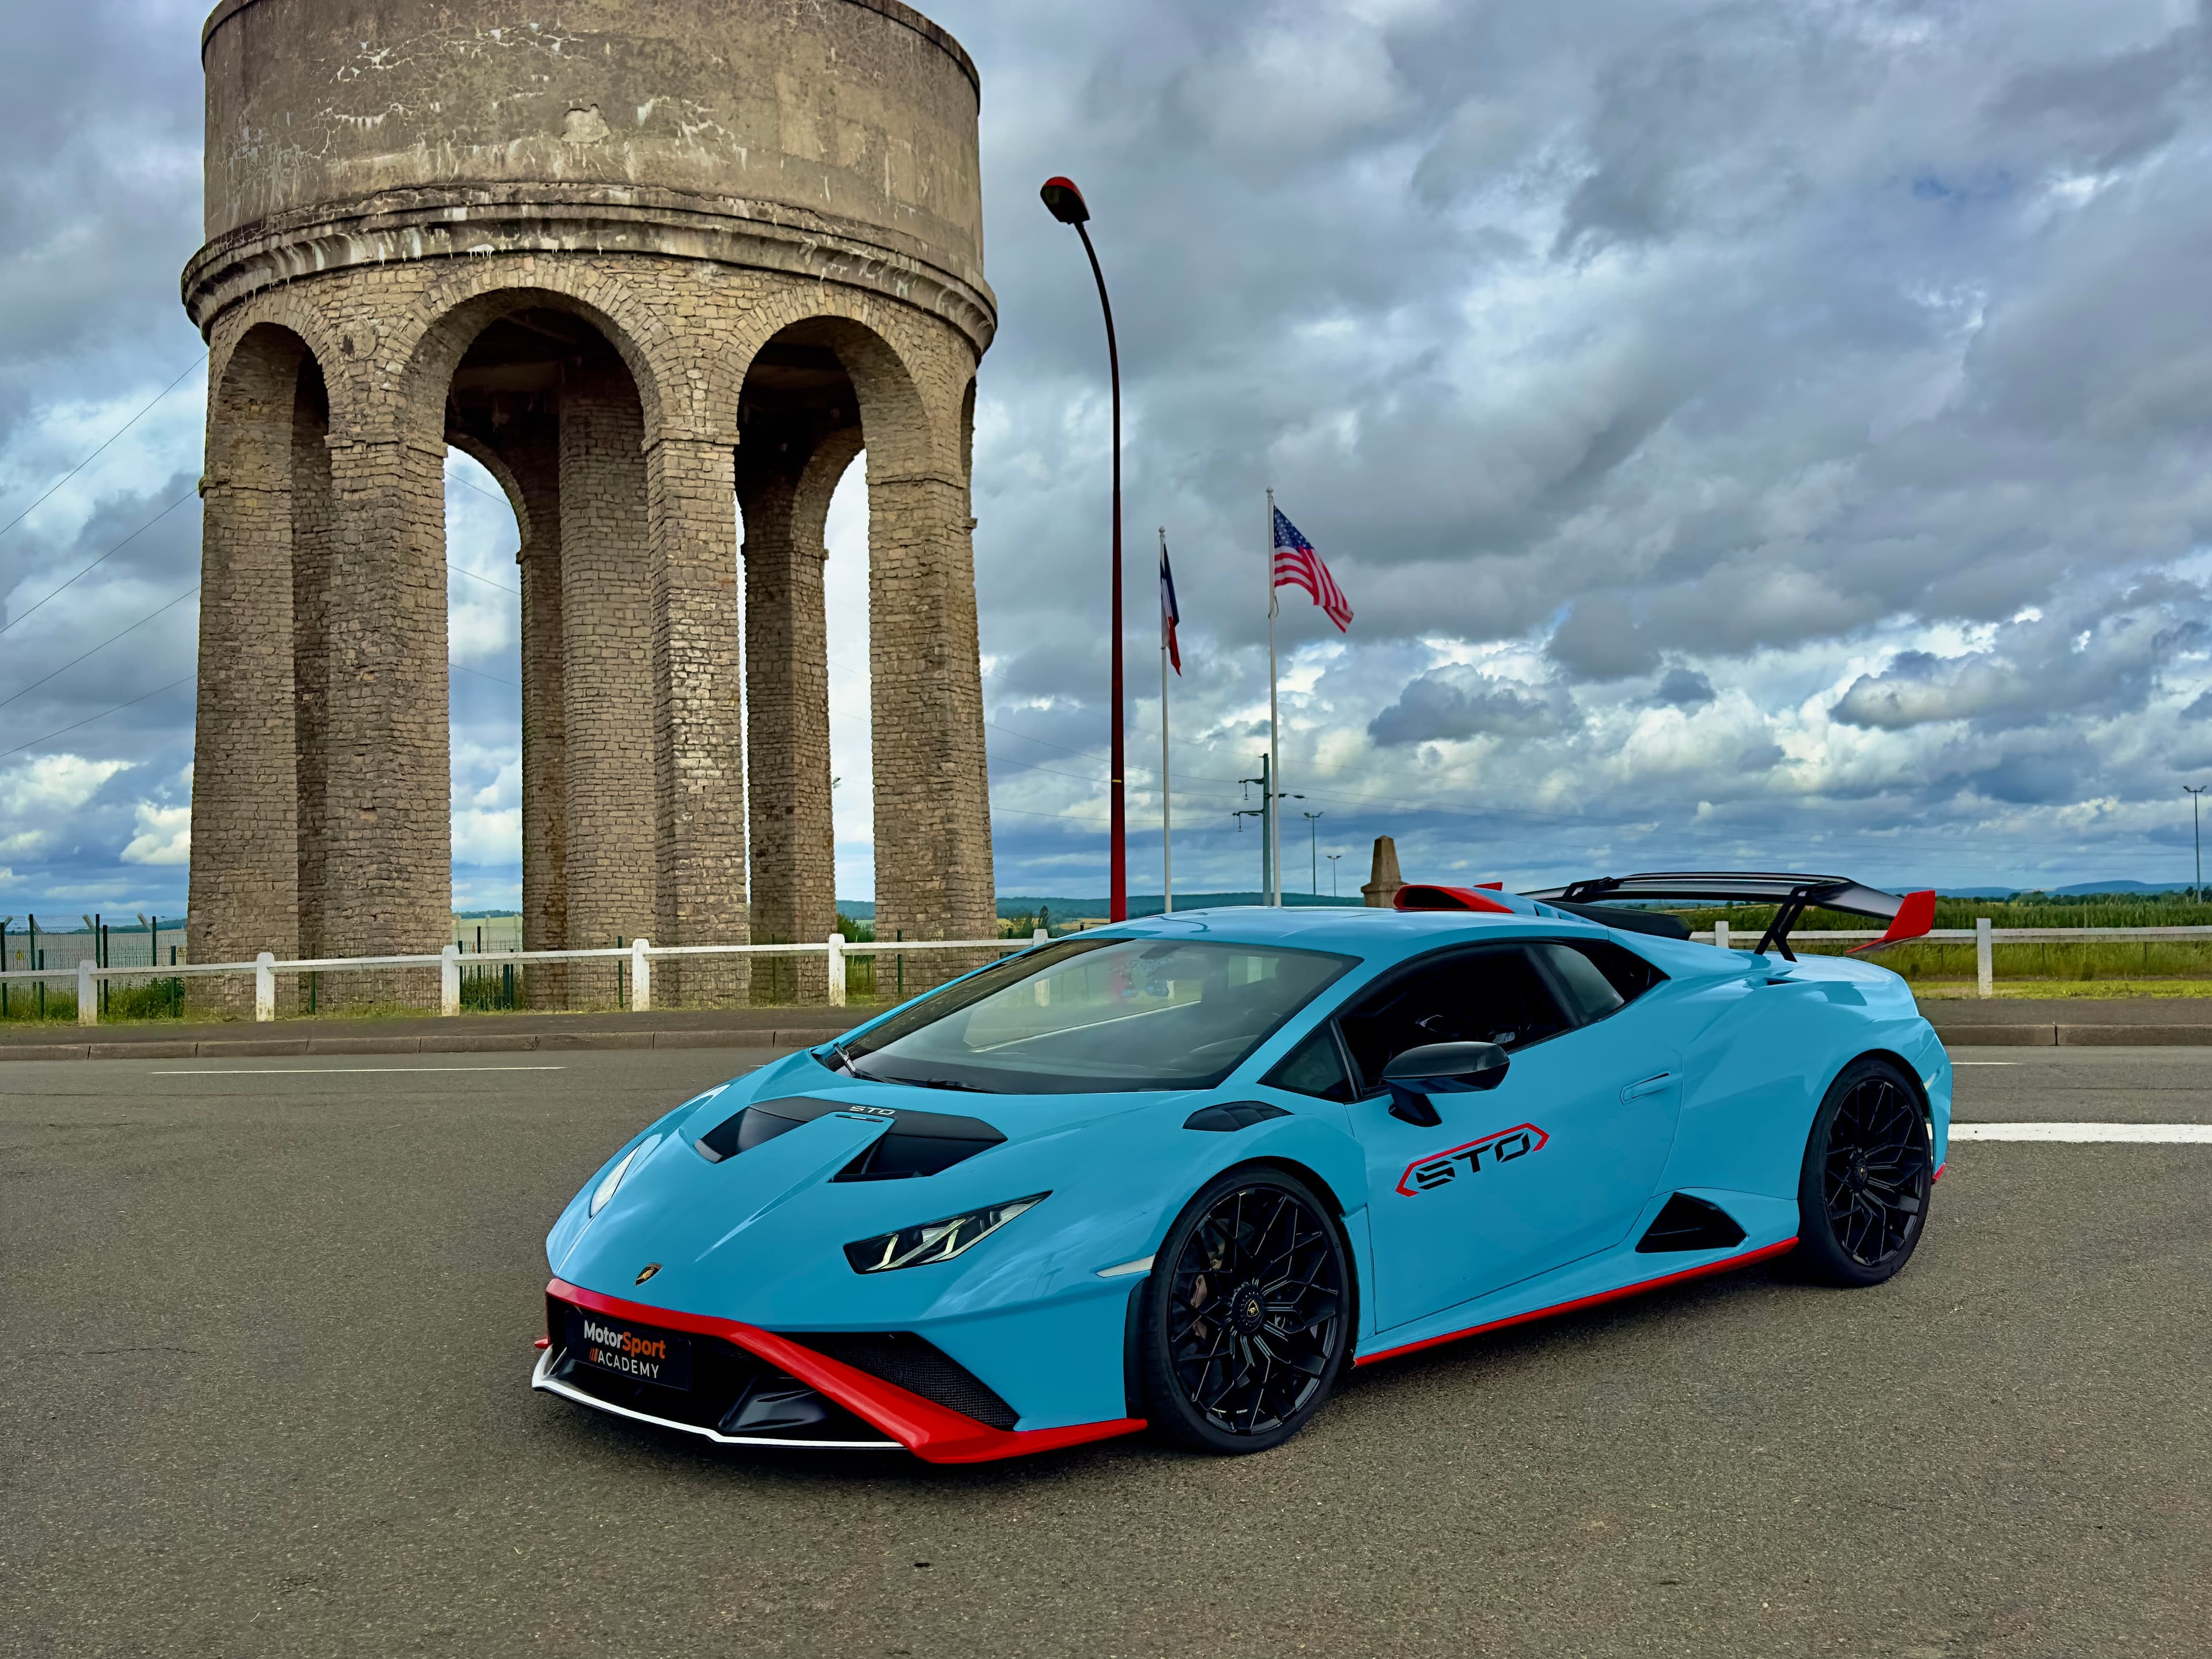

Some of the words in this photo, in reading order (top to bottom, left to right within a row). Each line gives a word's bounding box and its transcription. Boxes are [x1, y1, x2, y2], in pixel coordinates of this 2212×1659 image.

[849, 1105, 896, 1116] STO
[1415, 1132, 1531, 1190] STO
[584, 1320, 666, 1359] MotorSport
[597, 1350, 660, 1378] ACADEMY
